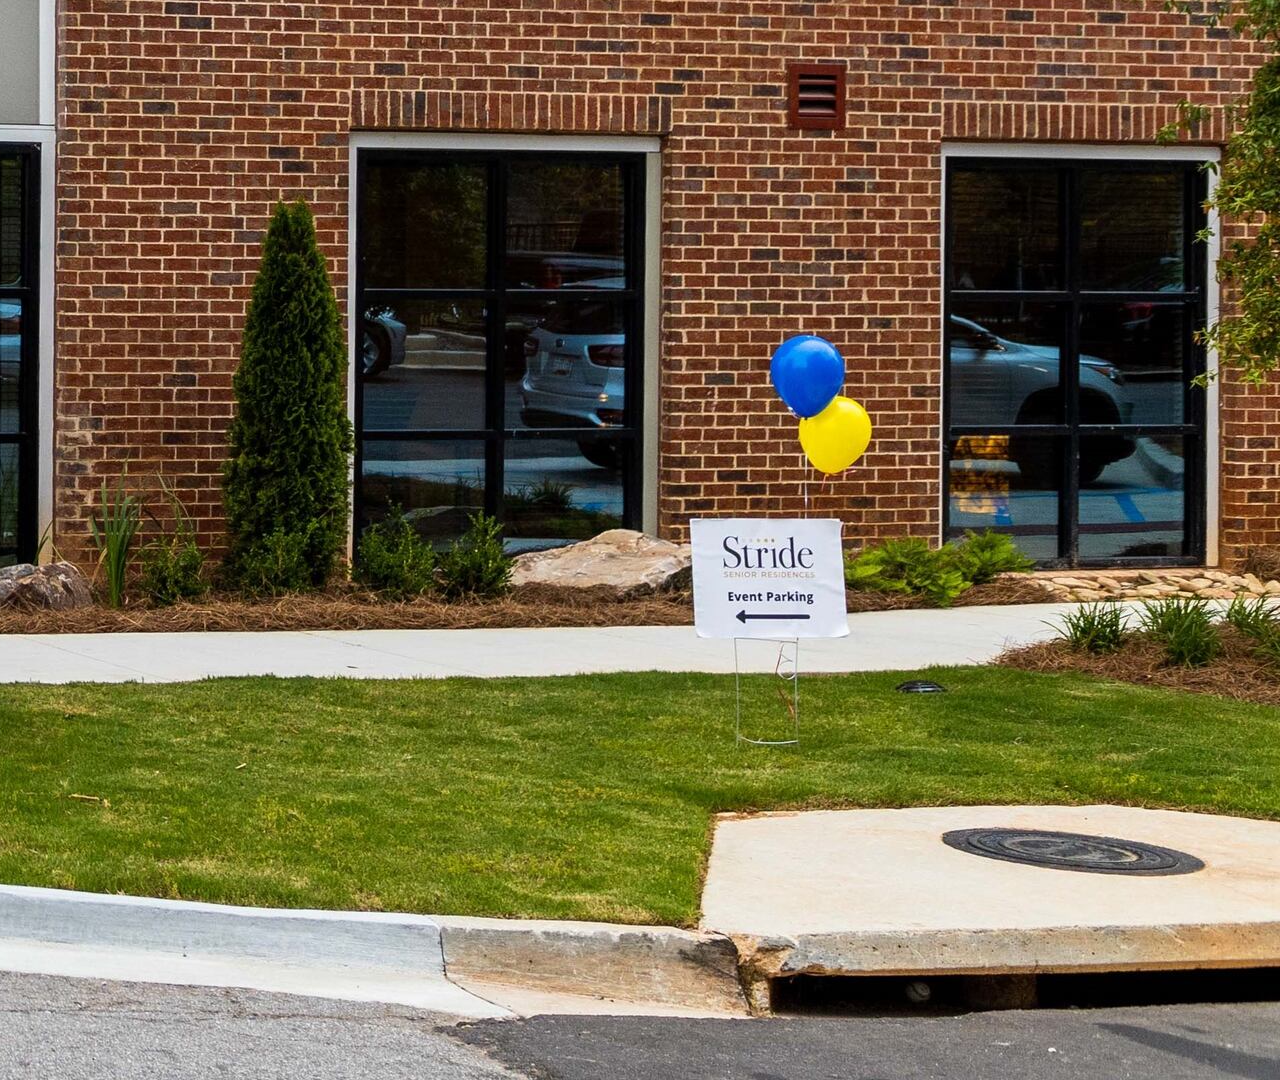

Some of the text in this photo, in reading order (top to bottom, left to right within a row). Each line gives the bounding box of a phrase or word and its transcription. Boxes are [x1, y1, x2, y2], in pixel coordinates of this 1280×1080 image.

[723, 536, 814, 569] Stride
[761, 571, 816, 579] RESIDENCES
[728, 591, 814, 605] Event Parking
